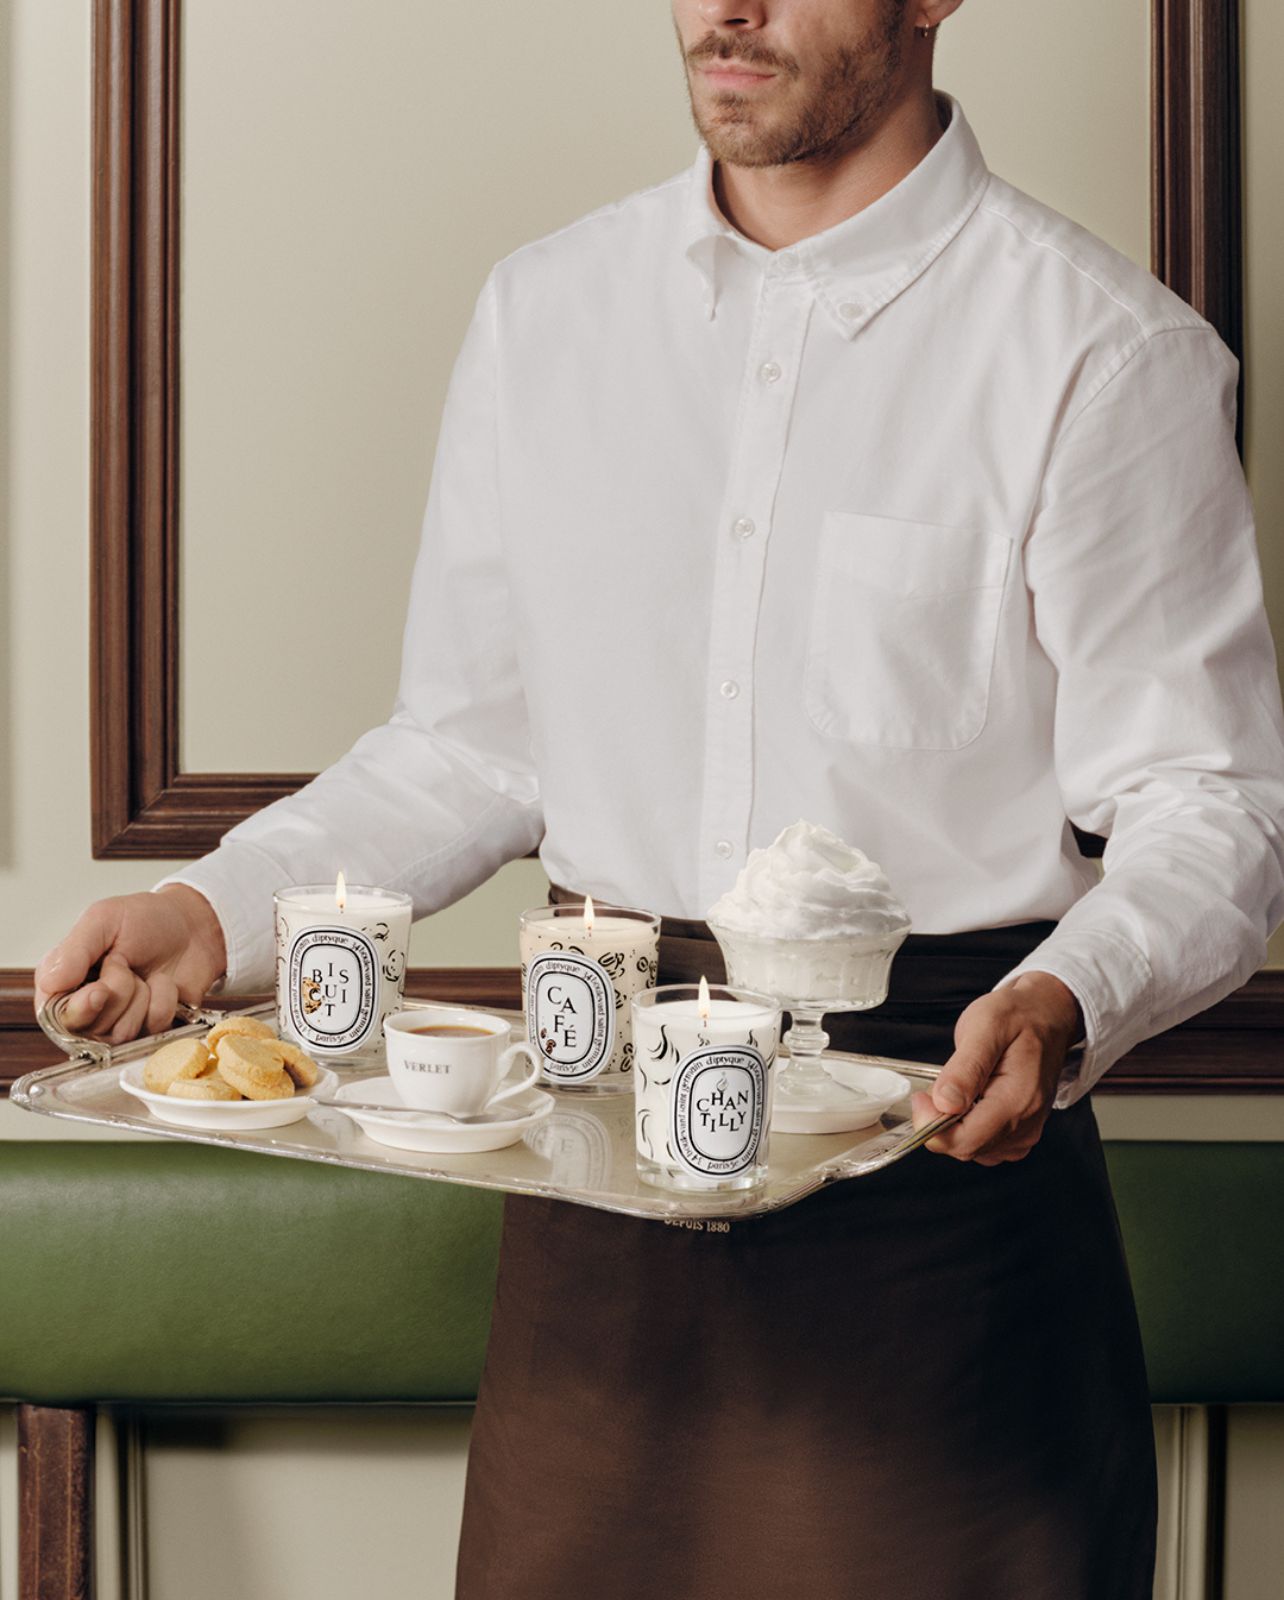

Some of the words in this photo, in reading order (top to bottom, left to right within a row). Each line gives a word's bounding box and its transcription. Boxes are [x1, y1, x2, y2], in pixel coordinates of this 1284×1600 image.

[403, 1060, 451, 1074] VERLET
[706, 1056, 745, 1066] diptyque
[682, 1062, 703, 1092] germain
[697, 1090, 748, 1111] CHAN
[700, 1111, 746, 1132] TILLY
[706, 1220, 731, 1233] 1880
